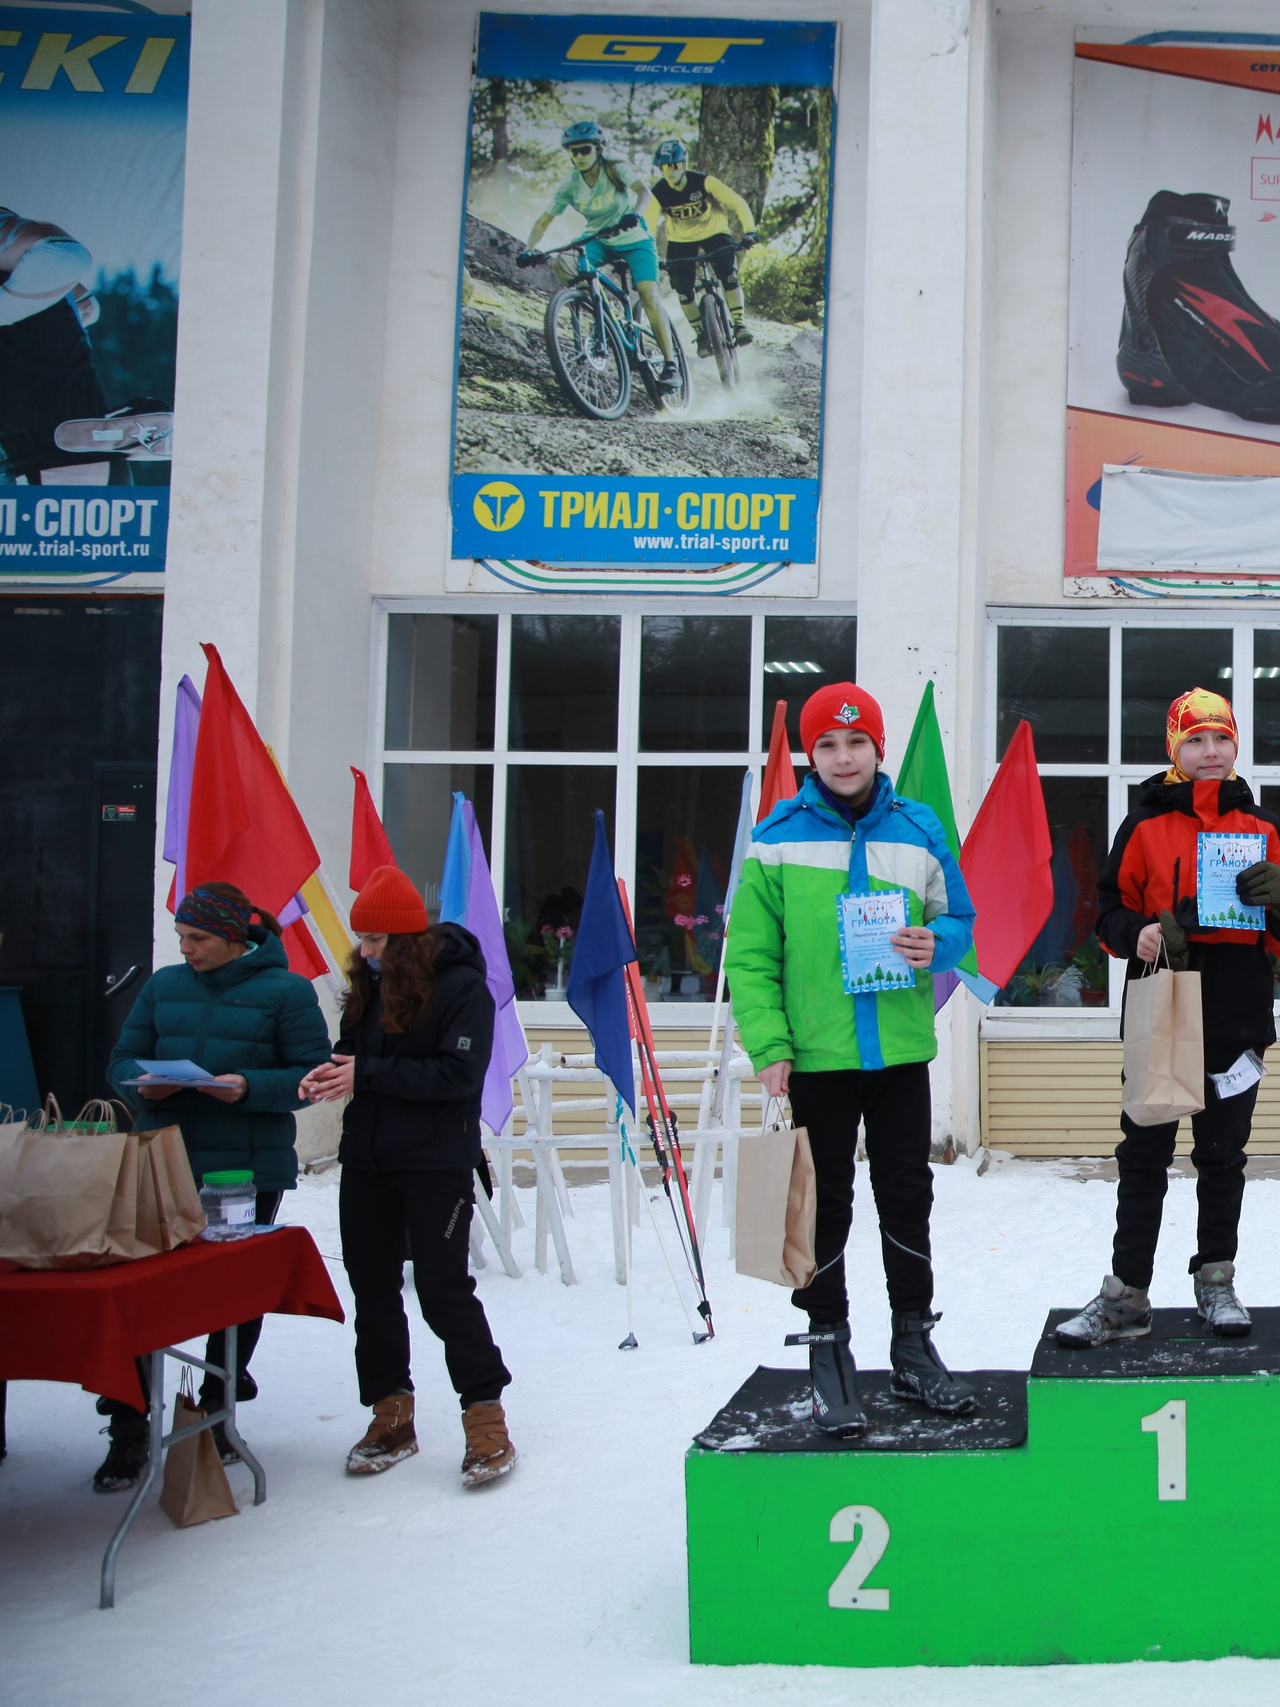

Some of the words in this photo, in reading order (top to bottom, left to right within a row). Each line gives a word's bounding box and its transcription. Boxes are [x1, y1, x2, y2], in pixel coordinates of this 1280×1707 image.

[566, 34, 765, 64] GT
[634, 64, 715, 74] BICYCLES
[669, 201, 703, 220] FOX
[634, 533, 789, 553] www.trial-sport.ru
[798, 1333, 835, 1343] SPINE
[1141, 1399, 1187, 1501] 1
[828, 1504, 890, 1611] 2
